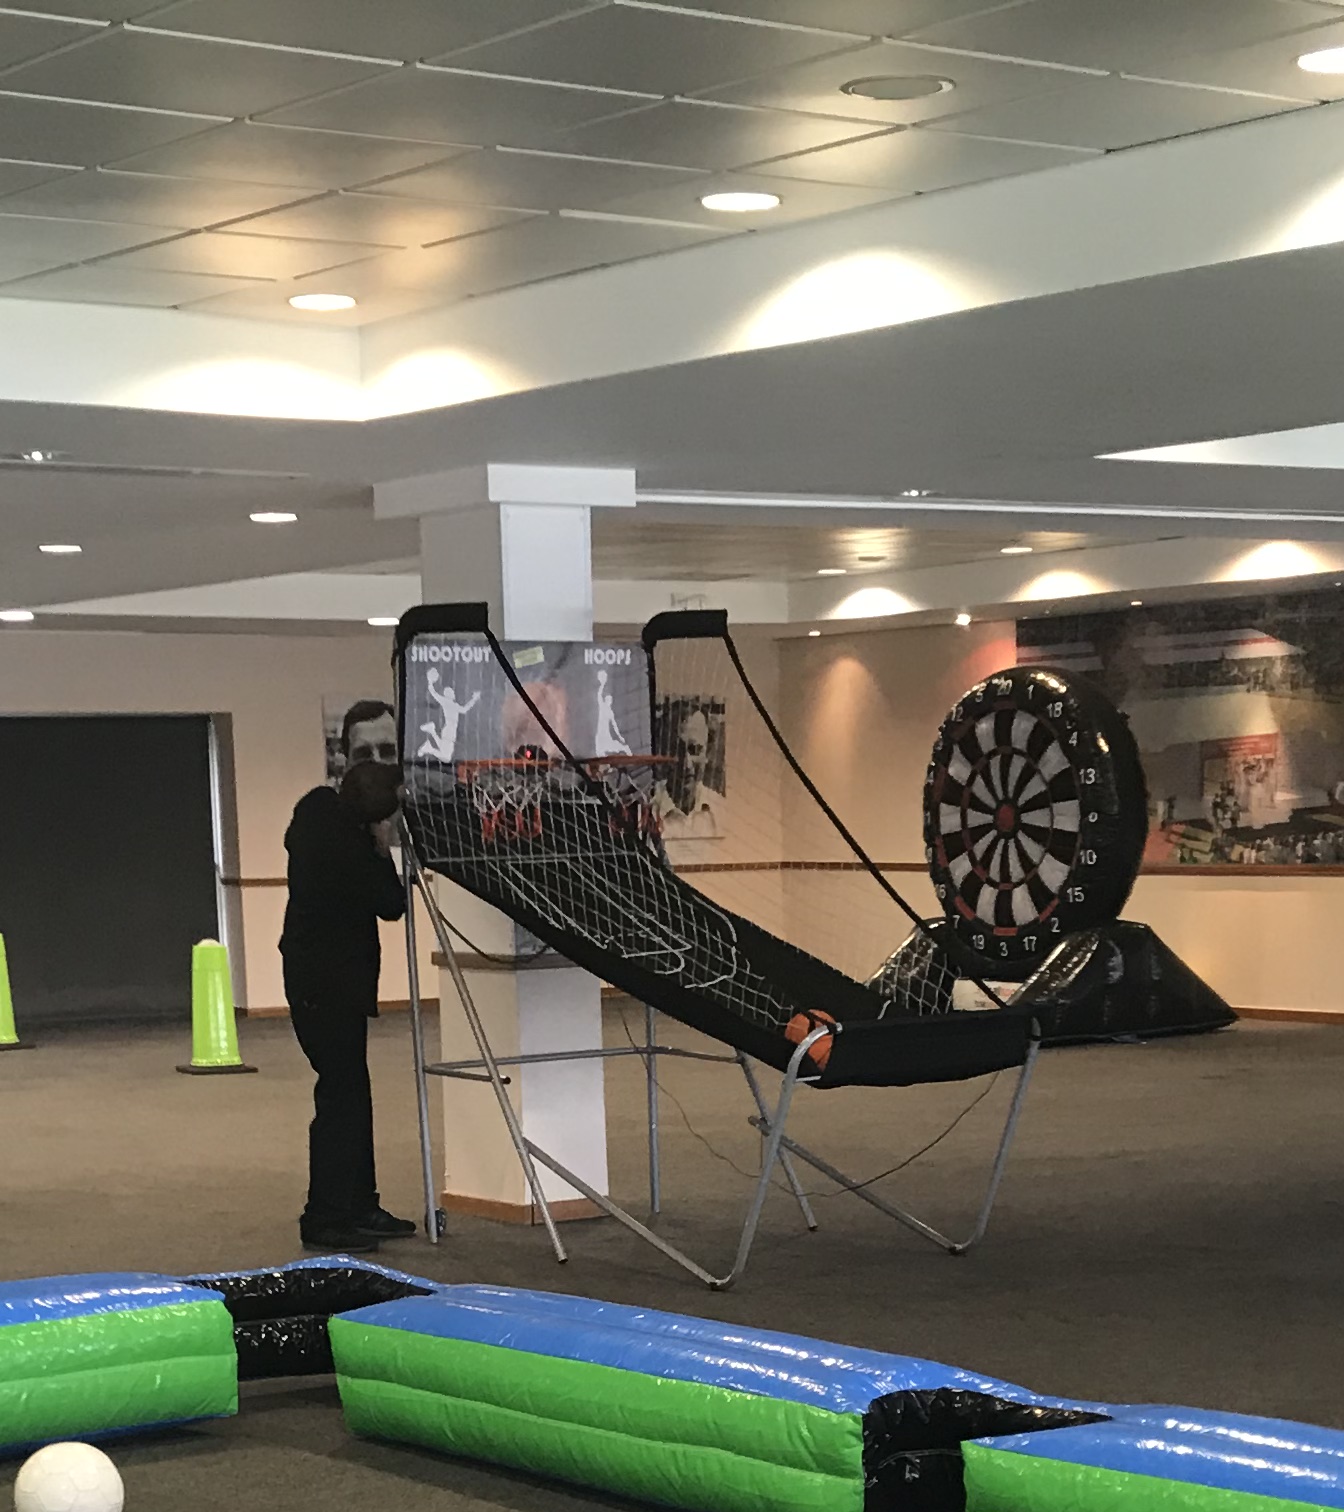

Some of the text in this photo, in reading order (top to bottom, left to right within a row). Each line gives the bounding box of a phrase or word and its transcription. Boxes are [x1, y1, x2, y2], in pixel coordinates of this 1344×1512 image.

[411, 646, 492, 664] SHOOTOUT
[584, 649, 632, 665] HOOPS
[1027, 684, 1035, 700] 1
[1046, 701, 1064, 718] 18
[1068, 731, 1078, 746] 4
[1079, 767, 1096, 785] 13
[1079, 849, 1097, 865] 10
[1066, 886, 1085, 903] 15
[952, 914, 961, 929] 7
[1051, 917, 1061, 933] 2
[999, 941, 1009, 957] 3
[1022, 935, 1037, 951] 17
